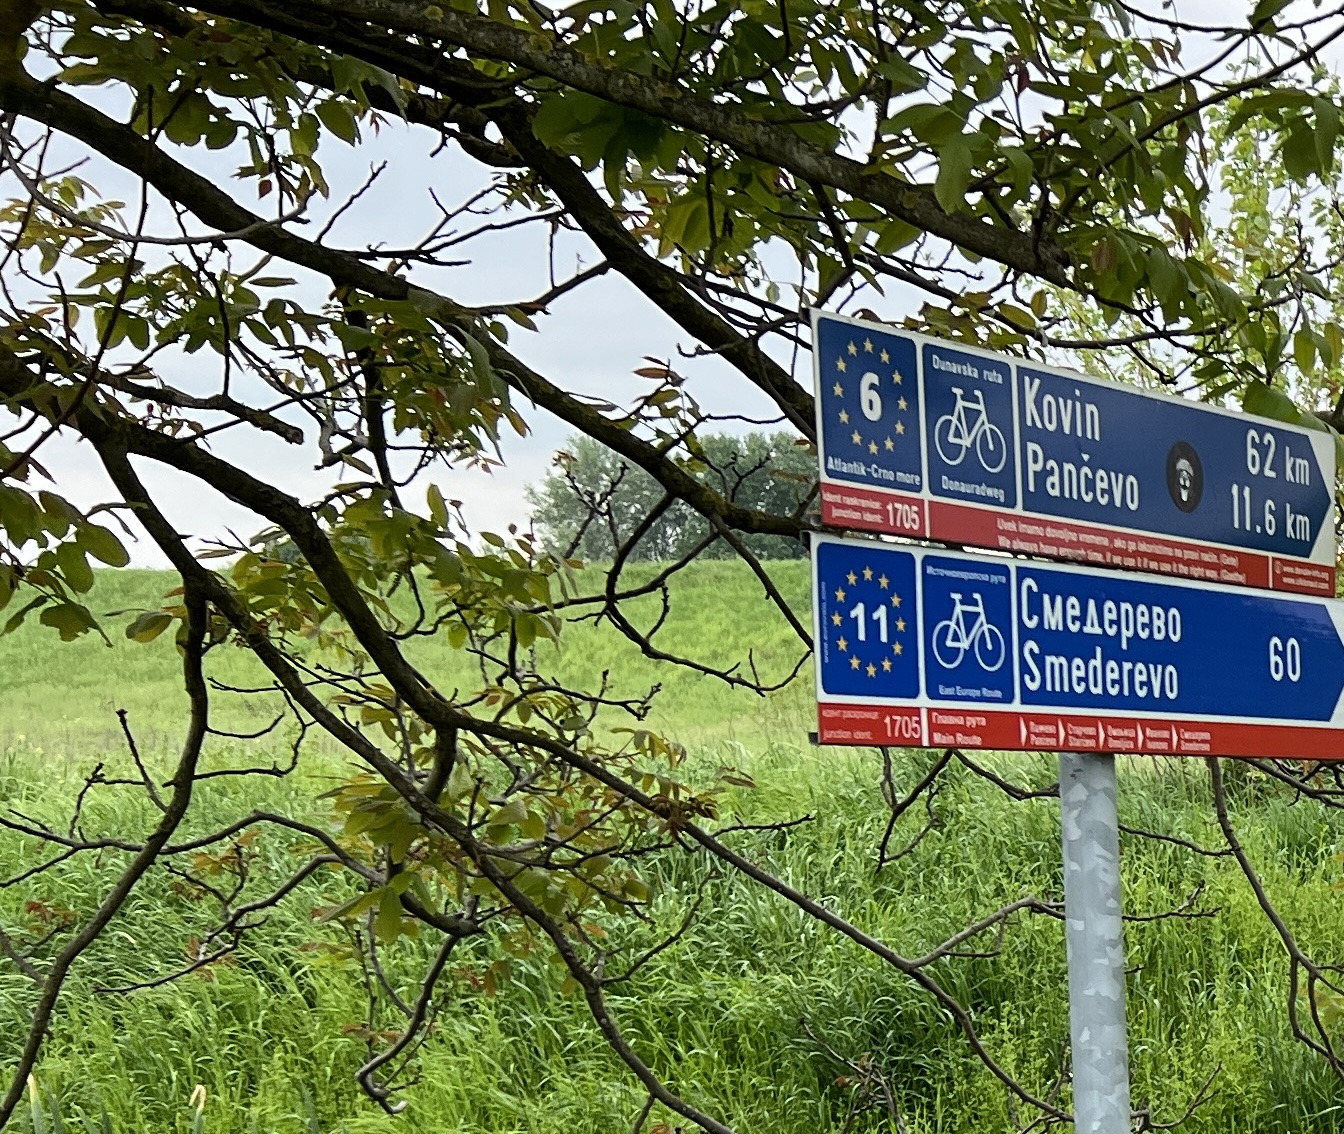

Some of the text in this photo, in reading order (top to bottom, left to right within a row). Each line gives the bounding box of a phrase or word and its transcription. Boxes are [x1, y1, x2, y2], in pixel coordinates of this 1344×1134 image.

[932, 354, 1003, 385] Dunavska ruta
[859, 372, 883, 422] 6
[1024, 375, 1310, 487] Kovin 62 km
[896, 471, 921, 486] more
[941, 475, 1005, 502] Donauradweg
[1026, 441, 1311, 543] Pančevo 11.6 km
[886, 501, 920, 530] 1705
[849, 602, 888, 643] 11
[1020, 577, 1182, 650] Смедерево
[1023, 636, 1301, 701] Smederevo 60
[884, 715, 921, 739] 1705
